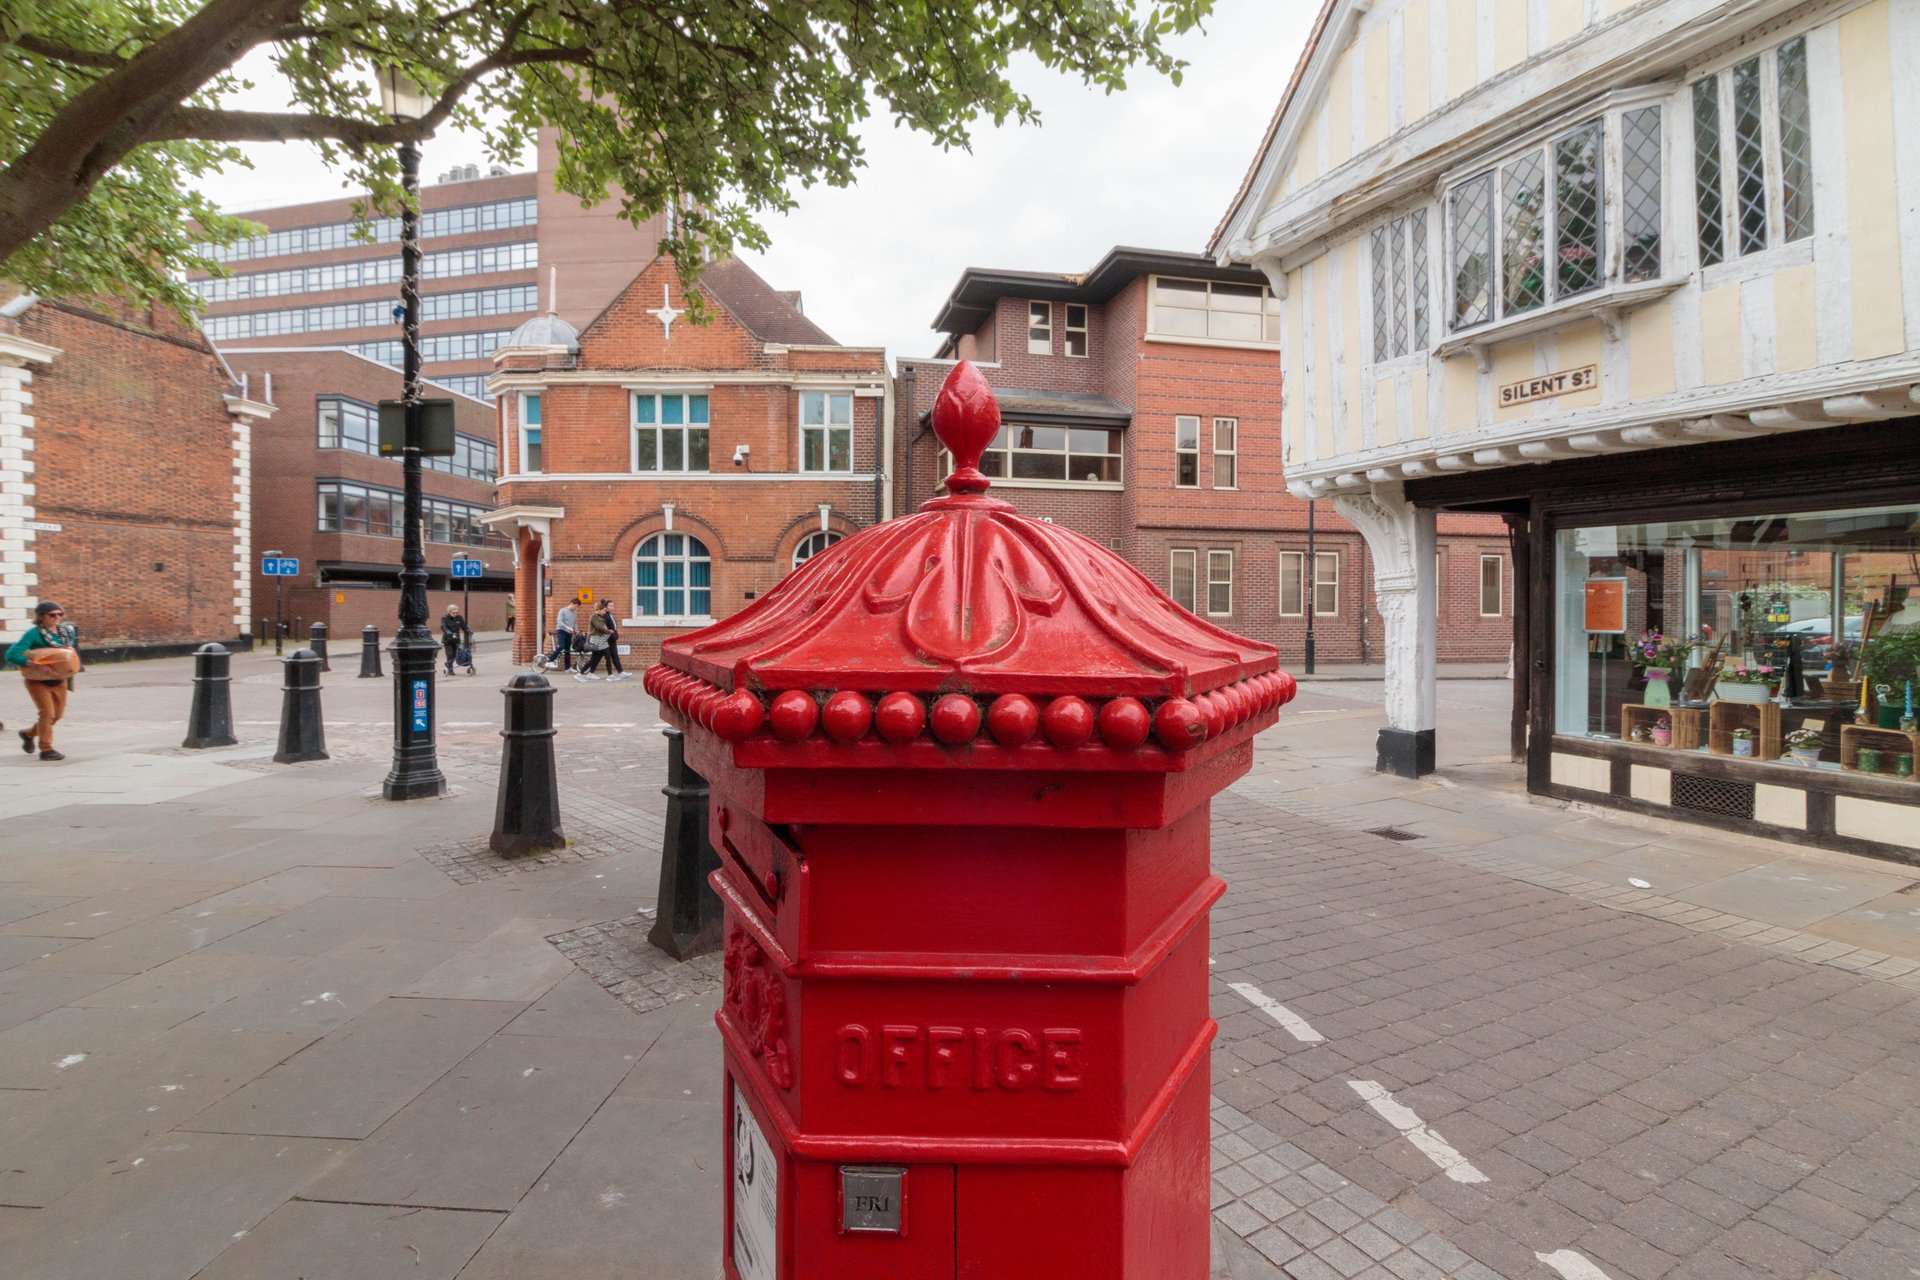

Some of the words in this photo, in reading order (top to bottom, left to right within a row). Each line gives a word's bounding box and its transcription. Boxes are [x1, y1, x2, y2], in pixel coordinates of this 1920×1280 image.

[1502, 375, 1567, 402] SILENT
[836, 1023, 1083, 1091] OFFICE
[855, 1196, 890, 1212] FRI
